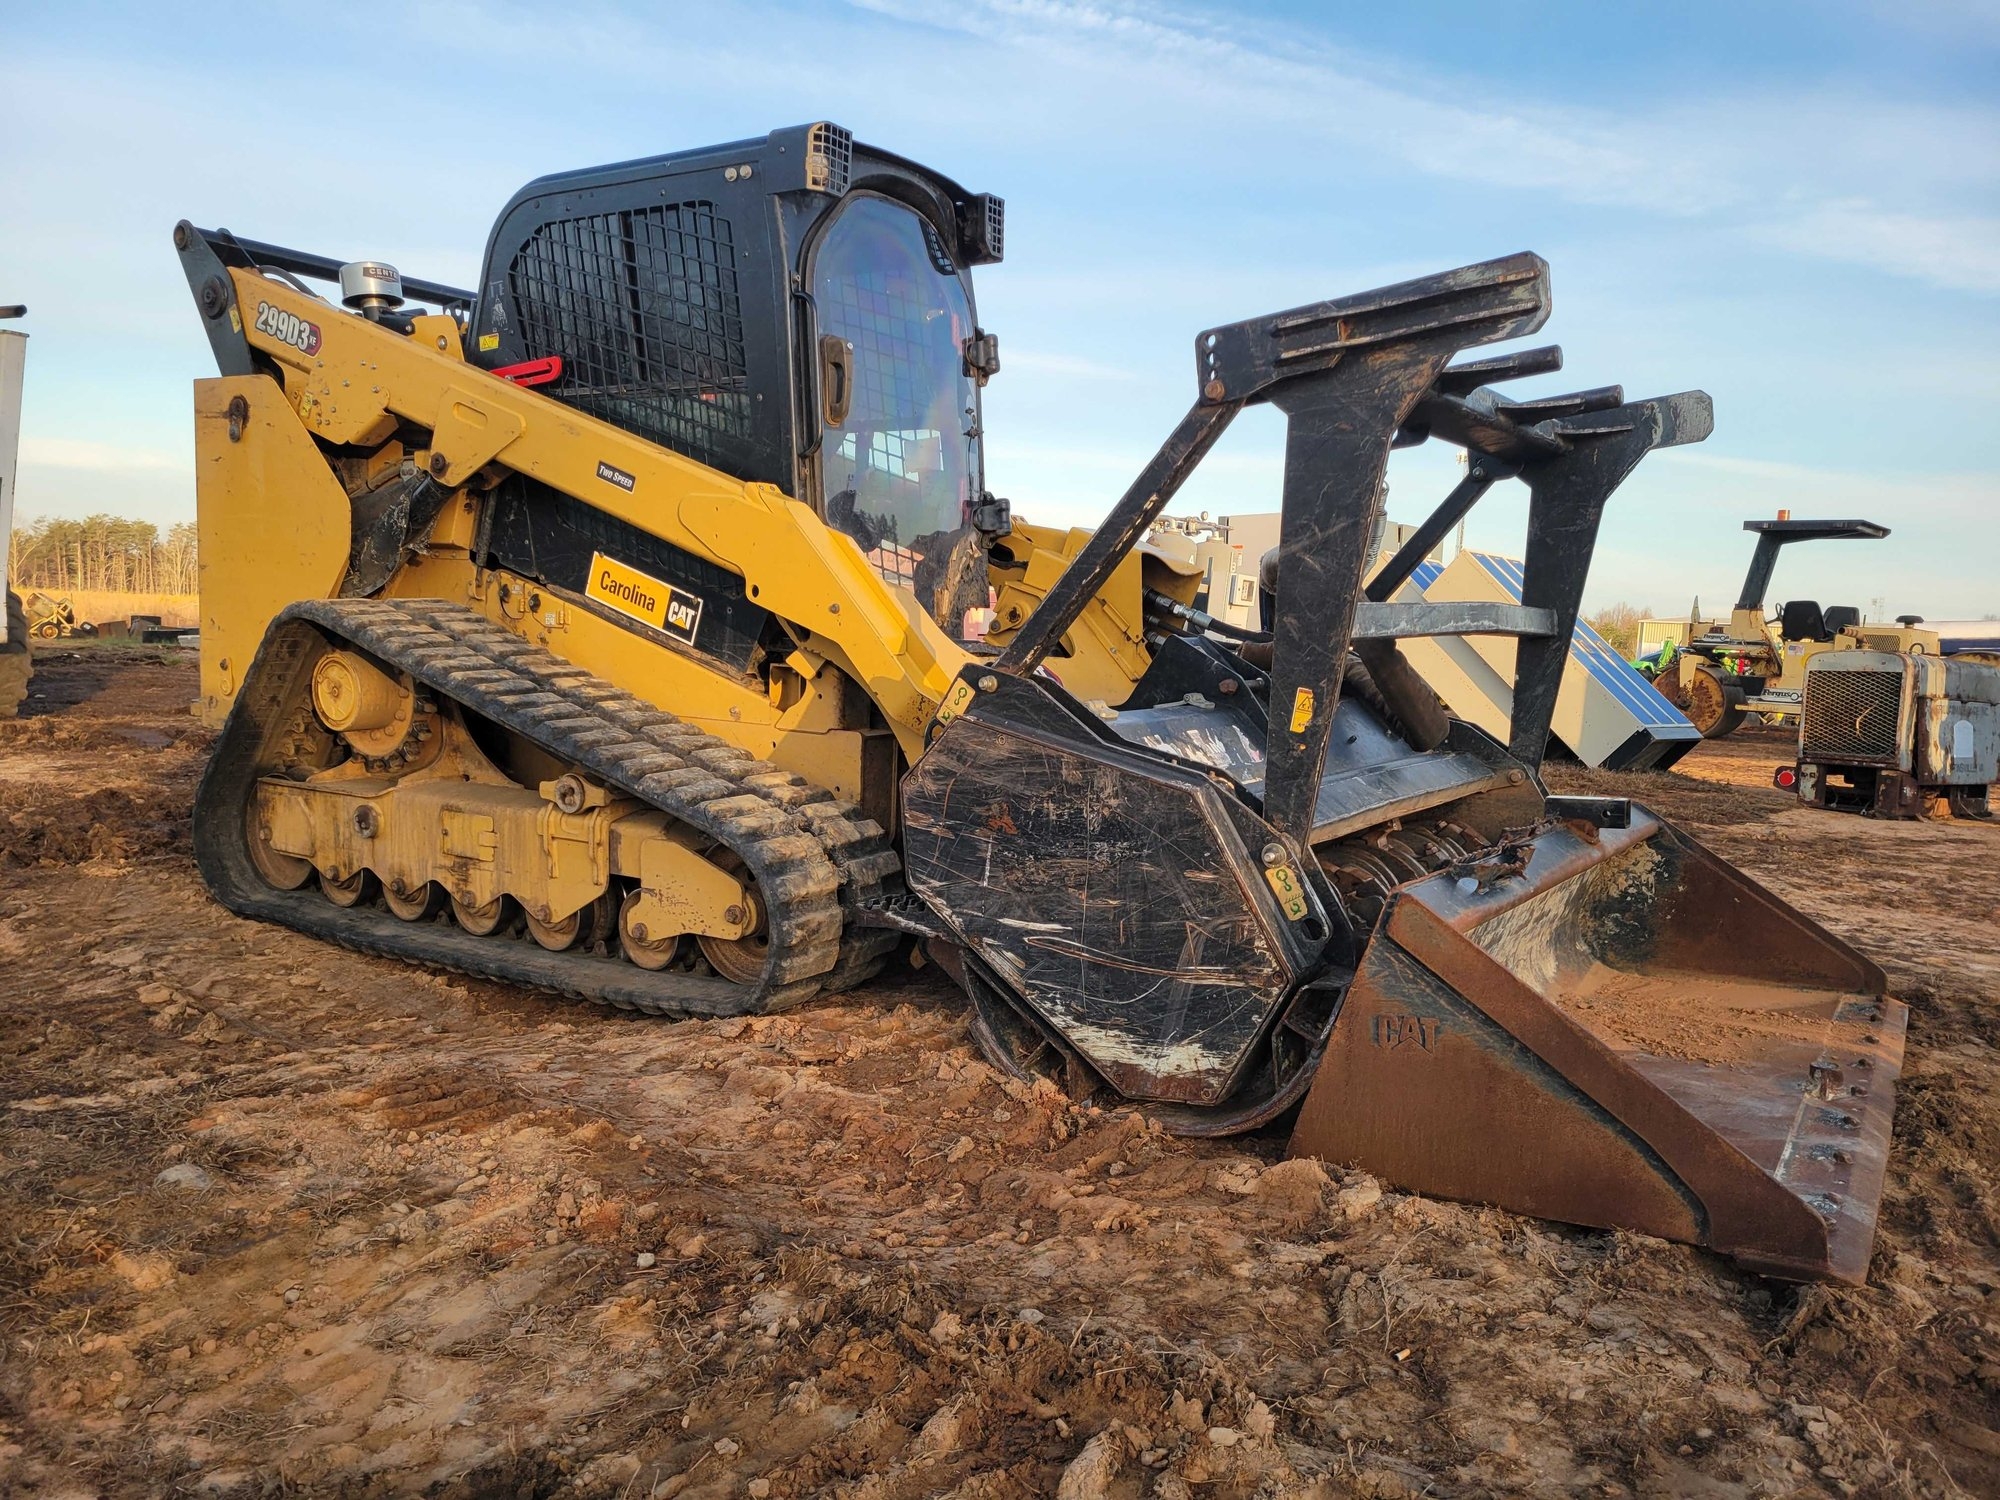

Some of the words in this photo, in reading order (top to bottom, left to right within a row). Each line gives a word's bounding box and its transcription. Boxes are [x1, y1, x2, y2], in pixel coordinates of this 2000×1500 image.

[255, 301, 310, 351] 299D3
[612, 471, 633, 488] SPEED
[599, 570, 656, 613] Carolina
[667, 601, 696, 631] CAT
[1376, 1012, 1440, 1056] CAT
